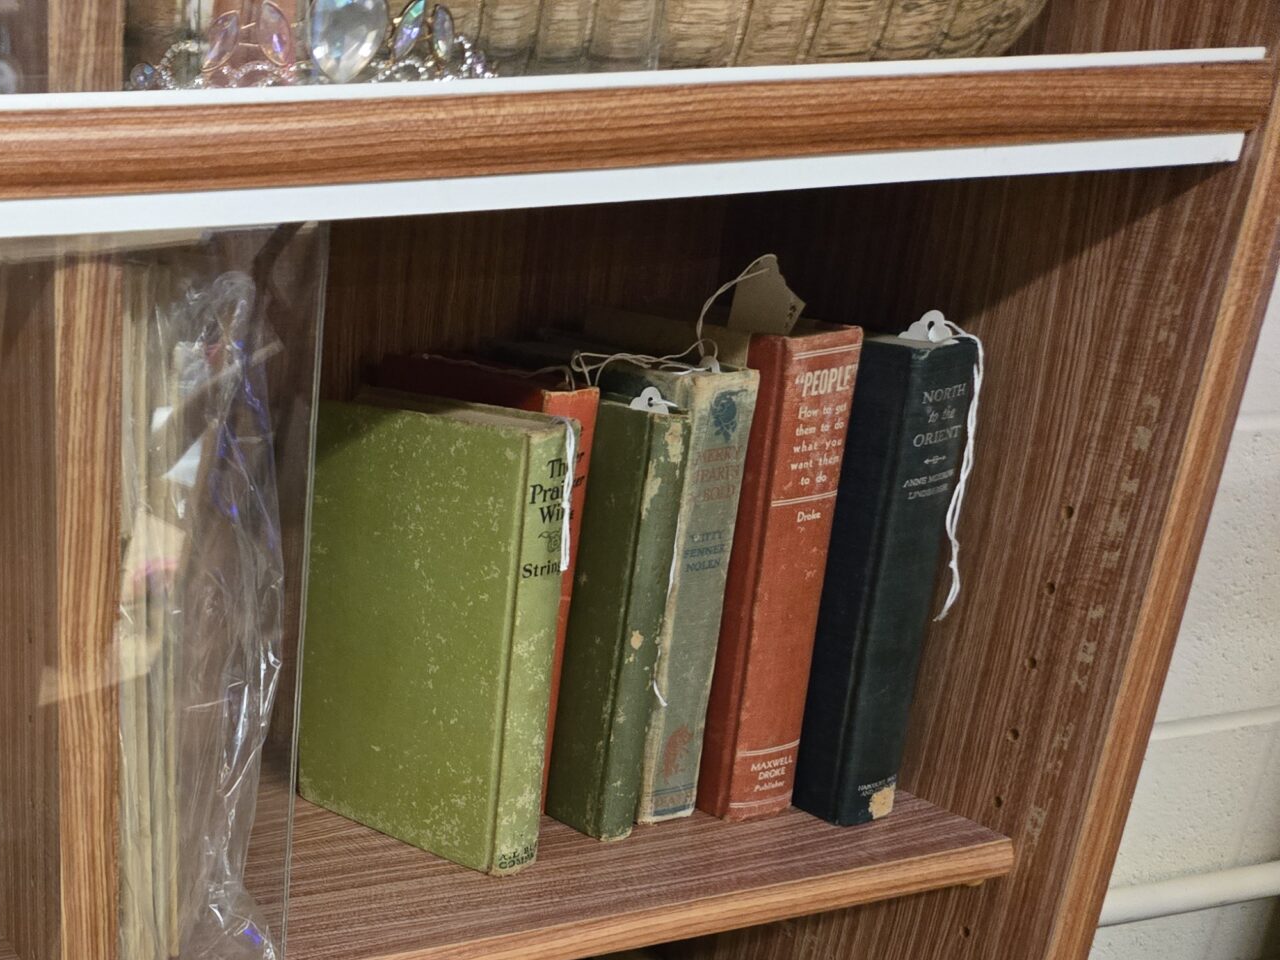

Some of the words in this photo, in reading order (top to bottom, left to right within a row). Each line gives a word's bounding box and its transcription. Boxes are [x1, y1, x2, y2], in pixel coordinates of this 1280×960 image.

[922, 382, 967, 405] NORTH
[798, 405, 819, 419] How
[822, 404, 833, 415] to
[835, 402, 847, 415] get
[795, 423, 816, 436] them
[820, 421, 830, 432] to
[834, 417, 845, 429] do
[912, 424, 962, 448] ORIENT
[793, 439, 818, 453] what
[825, 437, 842, 450] you
[790, 459, 813, 470] want
[818, 454, 840, 466] them
[800, 476, 810, 486] to
[816, 472, 827, 484] do
[750, 755, 793, 772] MAXWELL
[758, 766, 786, 780] DROKE
